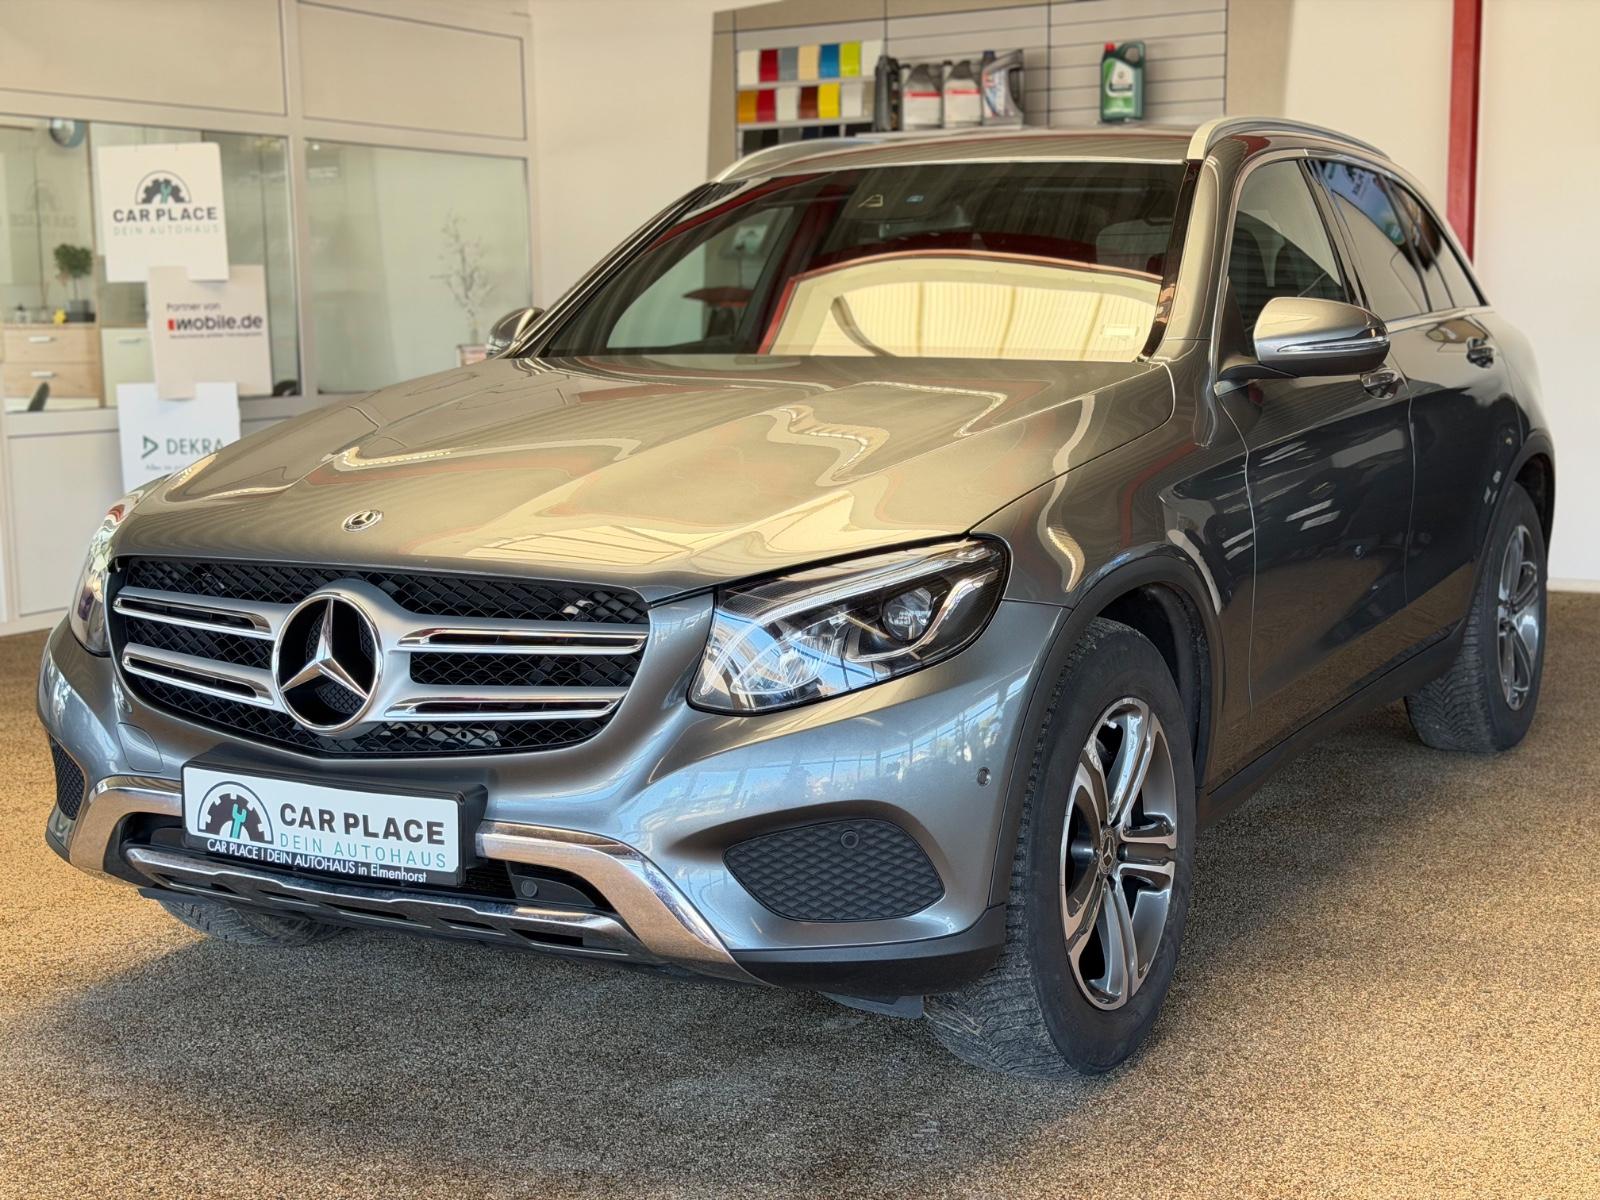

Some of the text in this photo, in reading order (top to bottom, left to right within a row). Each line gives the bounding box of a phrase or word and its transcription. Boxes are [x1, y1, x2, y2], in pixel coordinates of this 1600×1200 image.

[113, 206, 218, 222] CAR PLACE
[113, 224, 220, 236] DEIN AUTOHAUS
[166, 303, 221, 312] Partner von
[176, 315, 263, 330] mobile.de
[166, 438, 224, 455] DEKRA
[279, 802, 445, 846] CAR PLACE
[280, 832, 446, 869] DEIN AUTOHAUS
[207, 838, 228, 854] CAR
[229, 842, 259, 860] PLACE
[267, 849, 292, 865] DEIN
[294, 854, 356, 875] AUTOHAUS
[358, 863, 368, 876] in
[370, 864, 427, 883] Elmenhorst
